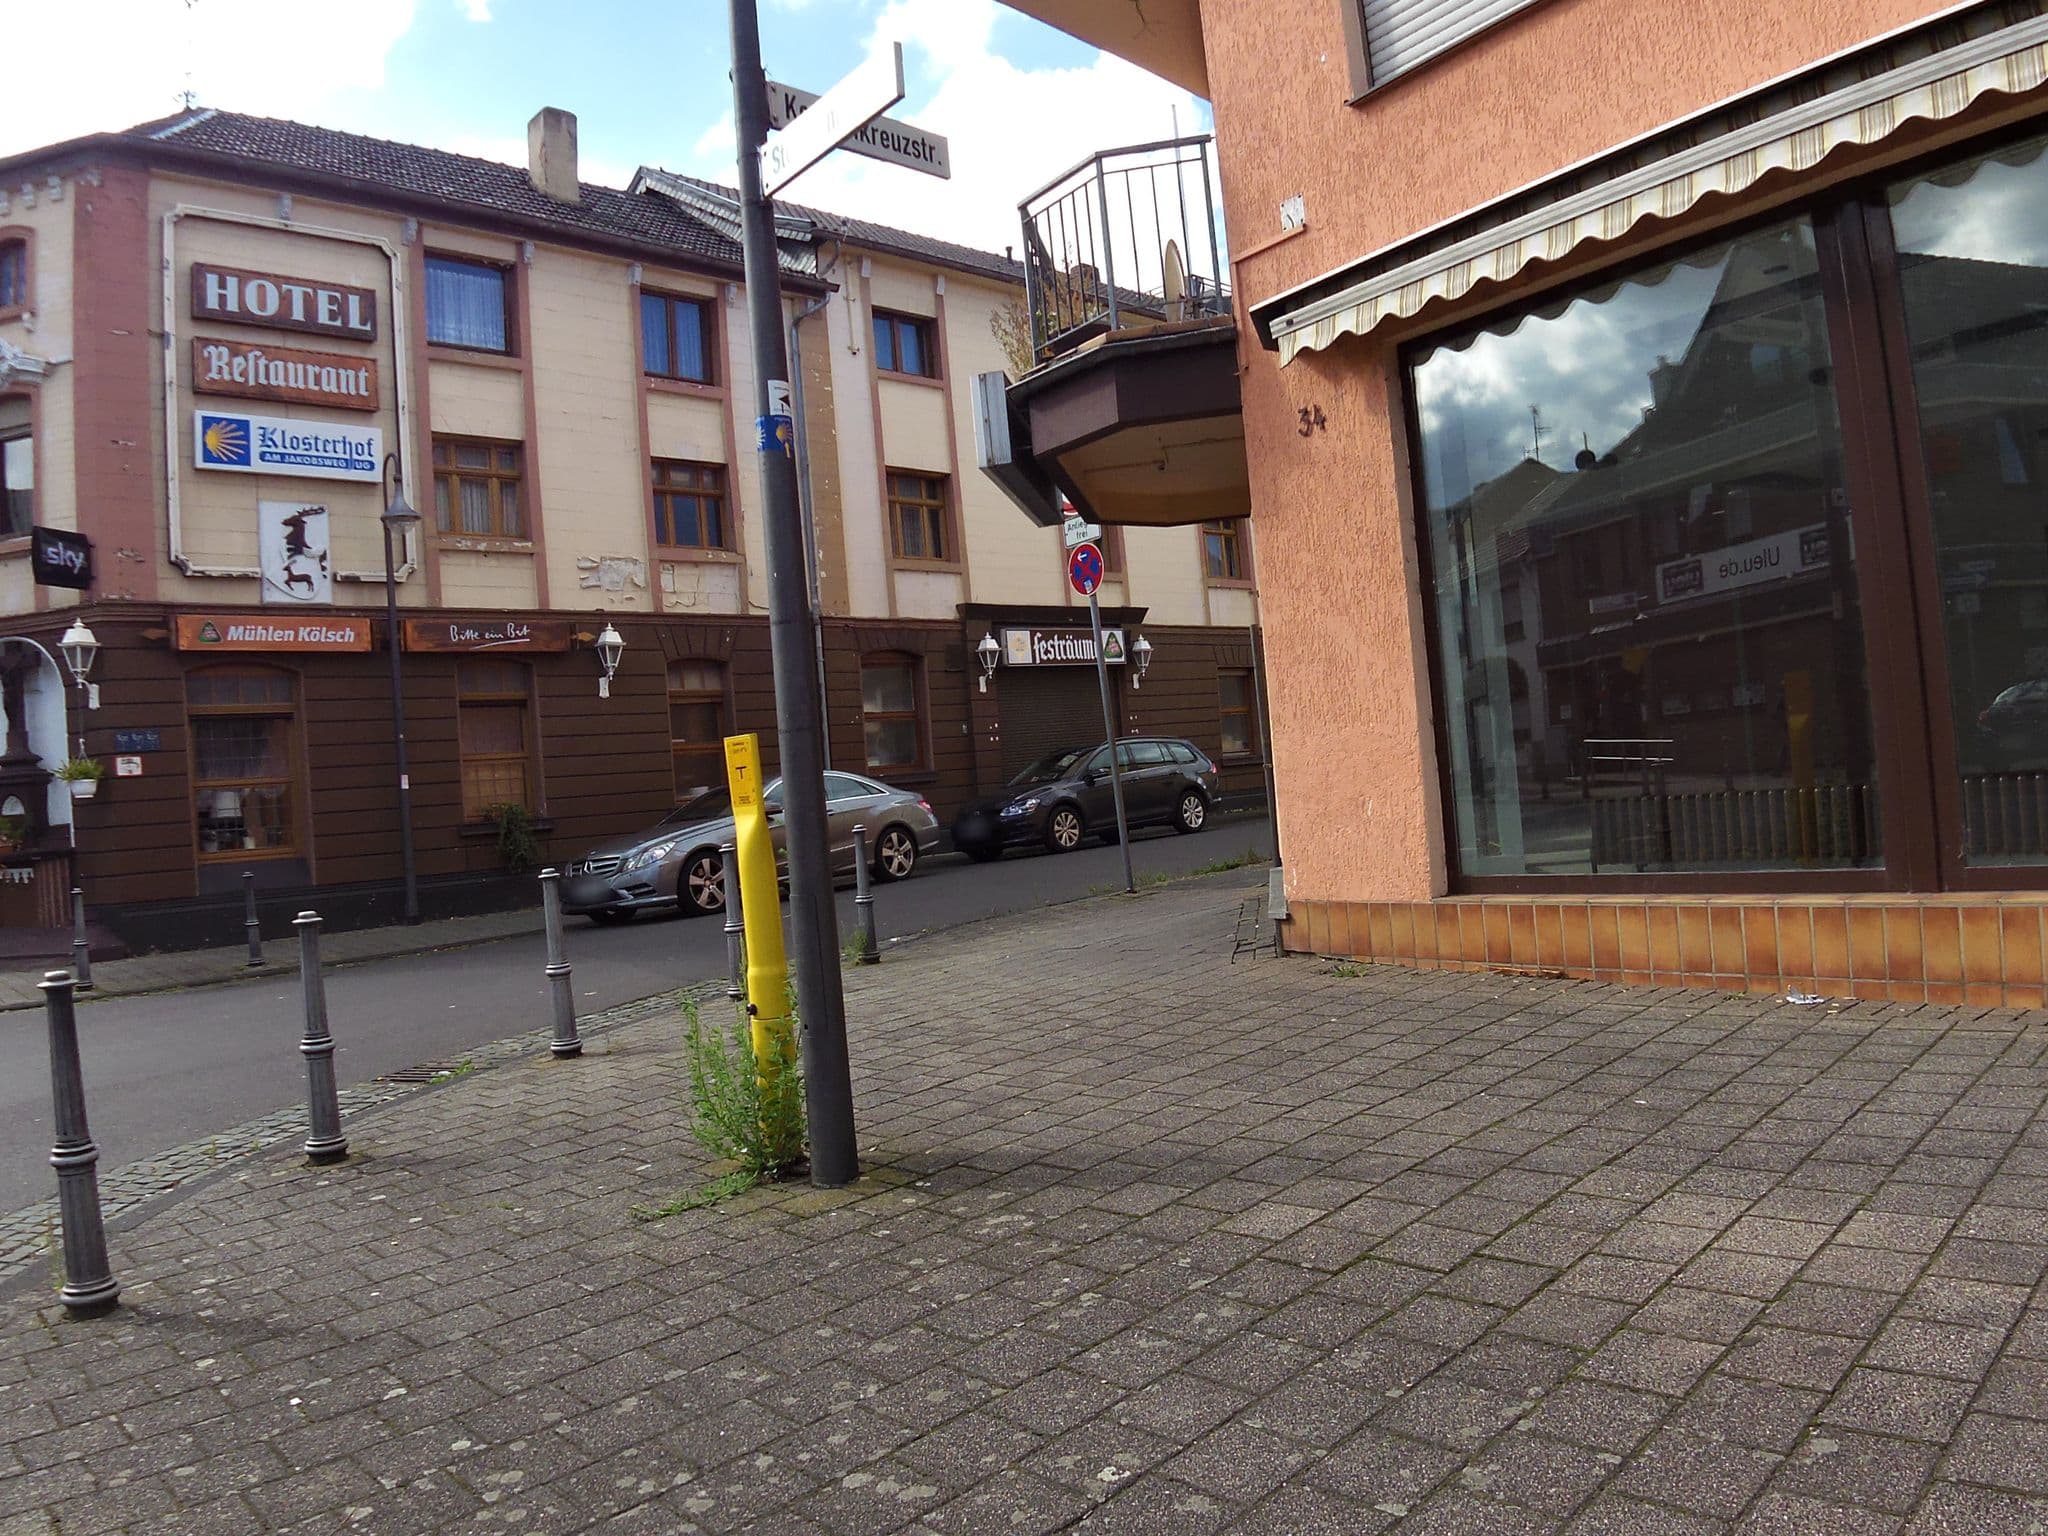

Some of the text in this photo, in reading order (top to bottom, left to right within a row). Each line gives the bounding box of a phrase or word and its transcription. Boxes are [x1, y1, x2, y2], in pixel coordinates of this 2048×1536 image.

[205, 272, 371, 331] HOTEL
[1298, 404, 1326, 437] 34
[258, 426, 374, 461] Klosterhof
[265, 452, 281, 462] AM
[284, 454, 347, 468] JAKOBSWEG
[47, 542, 85, 574] sky
[227, 625, 294, 642] Mühlen
[298, 626, 355, 643] Kölsch
[450, 622, 530, 642] Bitte ein Bit
[736, 766, 747, 780] T
